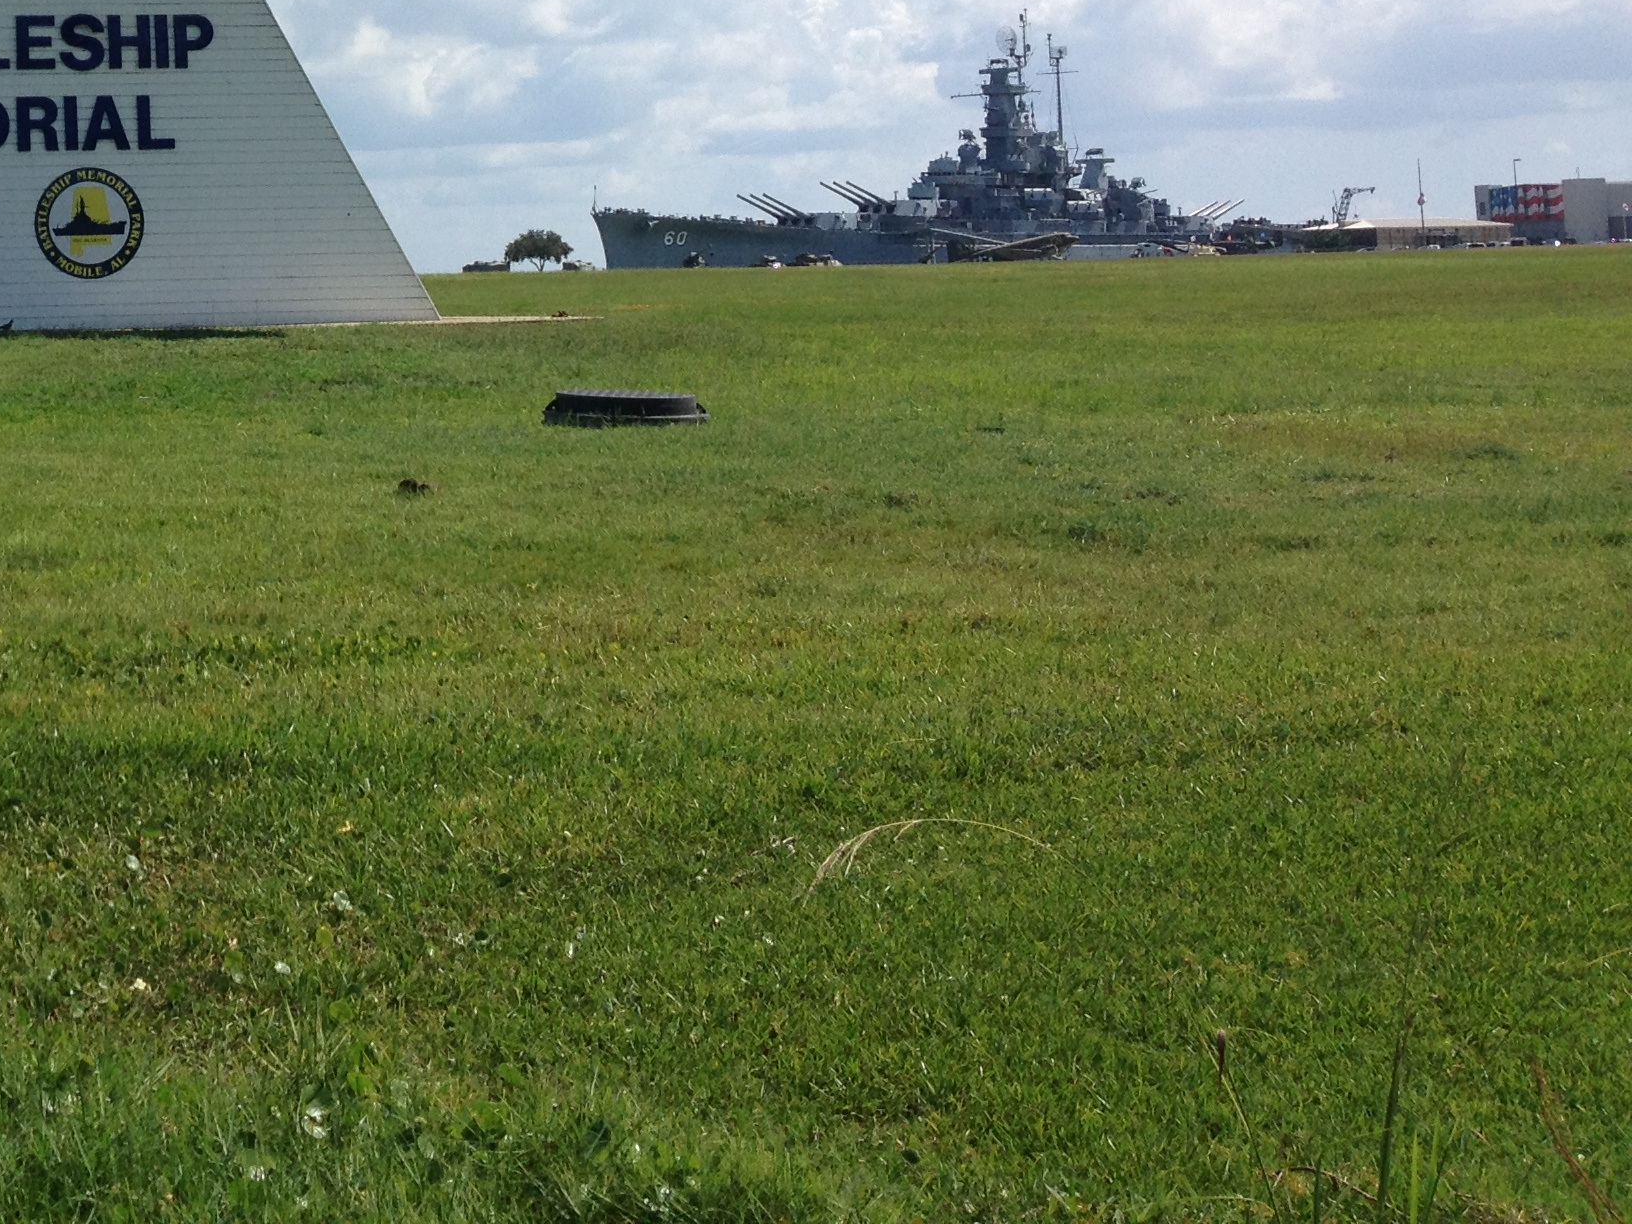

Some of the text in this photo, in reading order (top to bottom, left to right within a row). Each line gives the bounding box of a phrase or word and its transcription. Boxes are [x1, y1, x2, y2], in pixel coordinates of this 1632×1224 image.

[38, 170, 141, 251] BATTLESHIP MEMORIAL PARK
[664, 230, 688, 246] 60
[110, 256, 126, 271] AL
